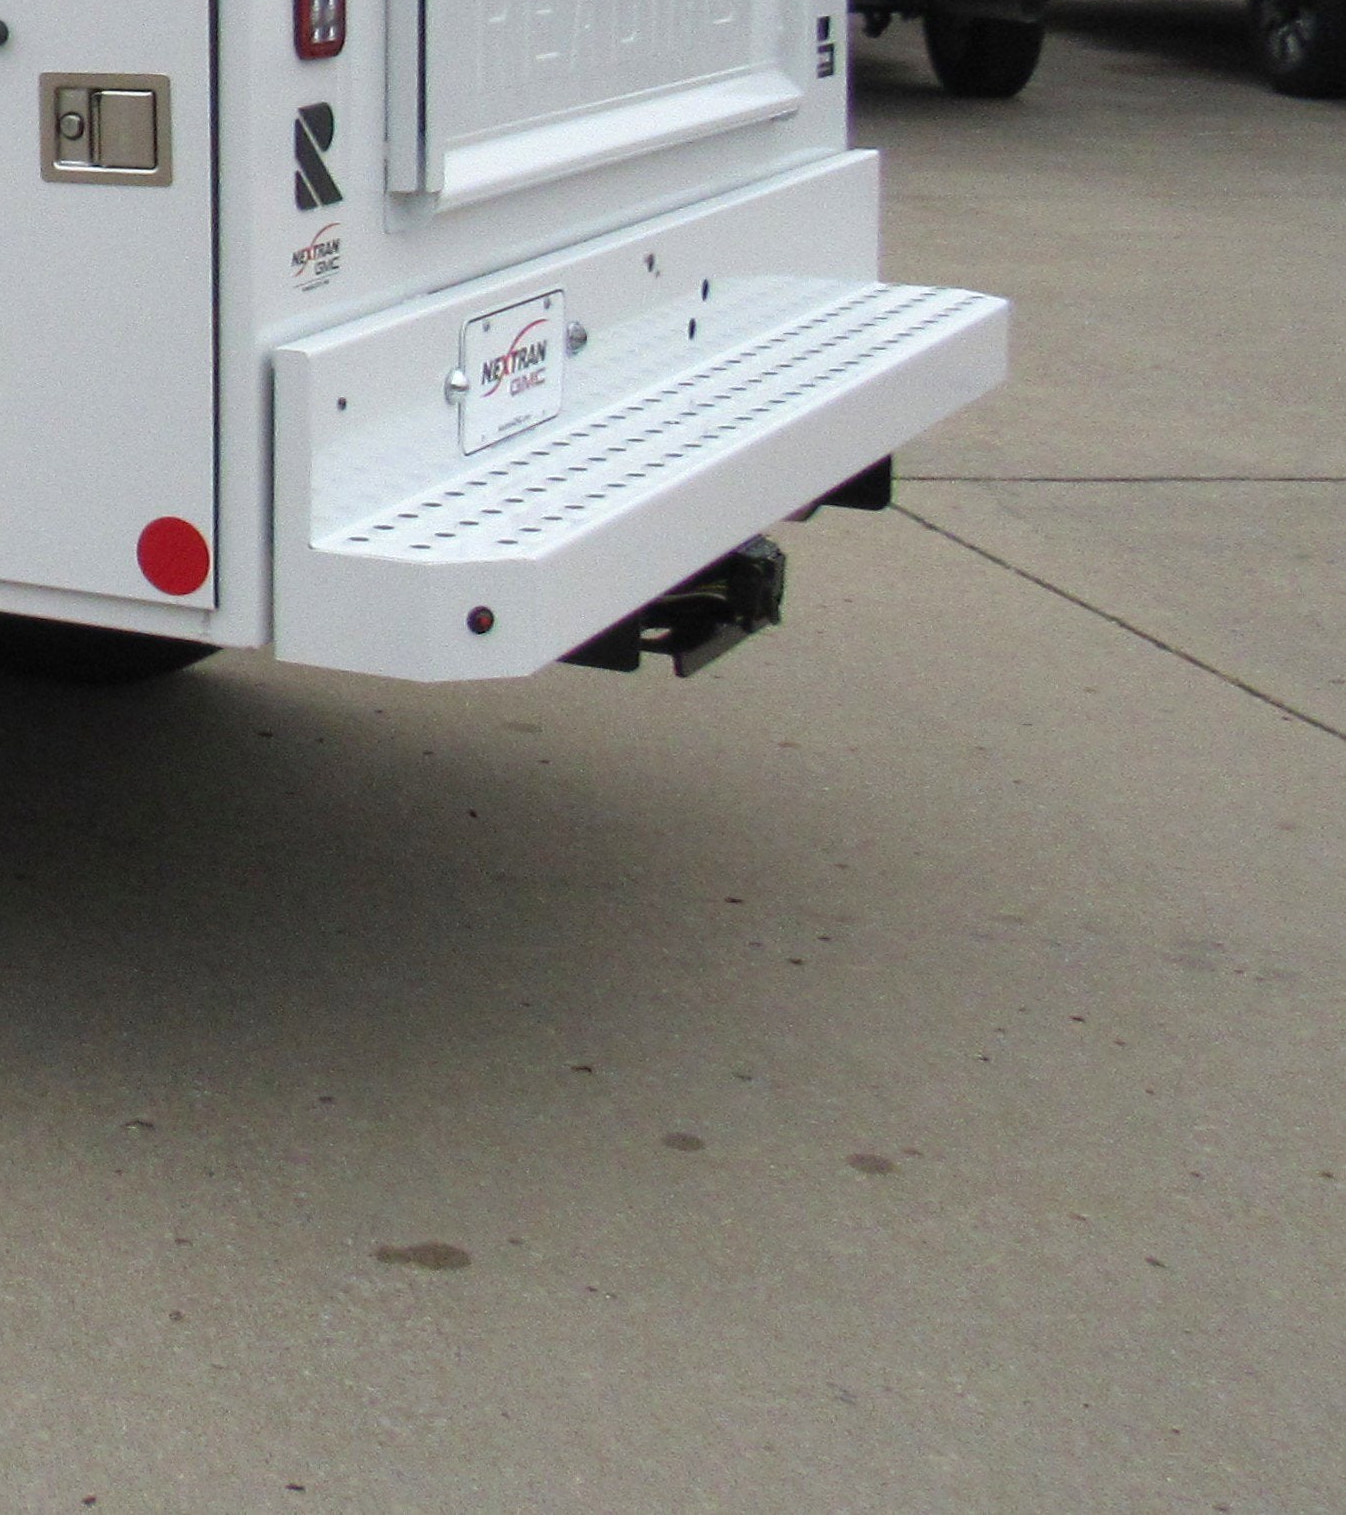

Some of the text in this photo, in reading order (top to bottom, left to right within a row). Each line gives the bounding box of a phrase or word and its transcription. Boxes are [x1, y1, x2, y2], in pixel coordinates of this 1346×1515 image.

[291, 238, 341, 267] NEXTRAN
[314, 256, 341, 276] GMC
[481, 340, 548, 385] NEXTRAN
[510, 367, 547, 396] GMC
